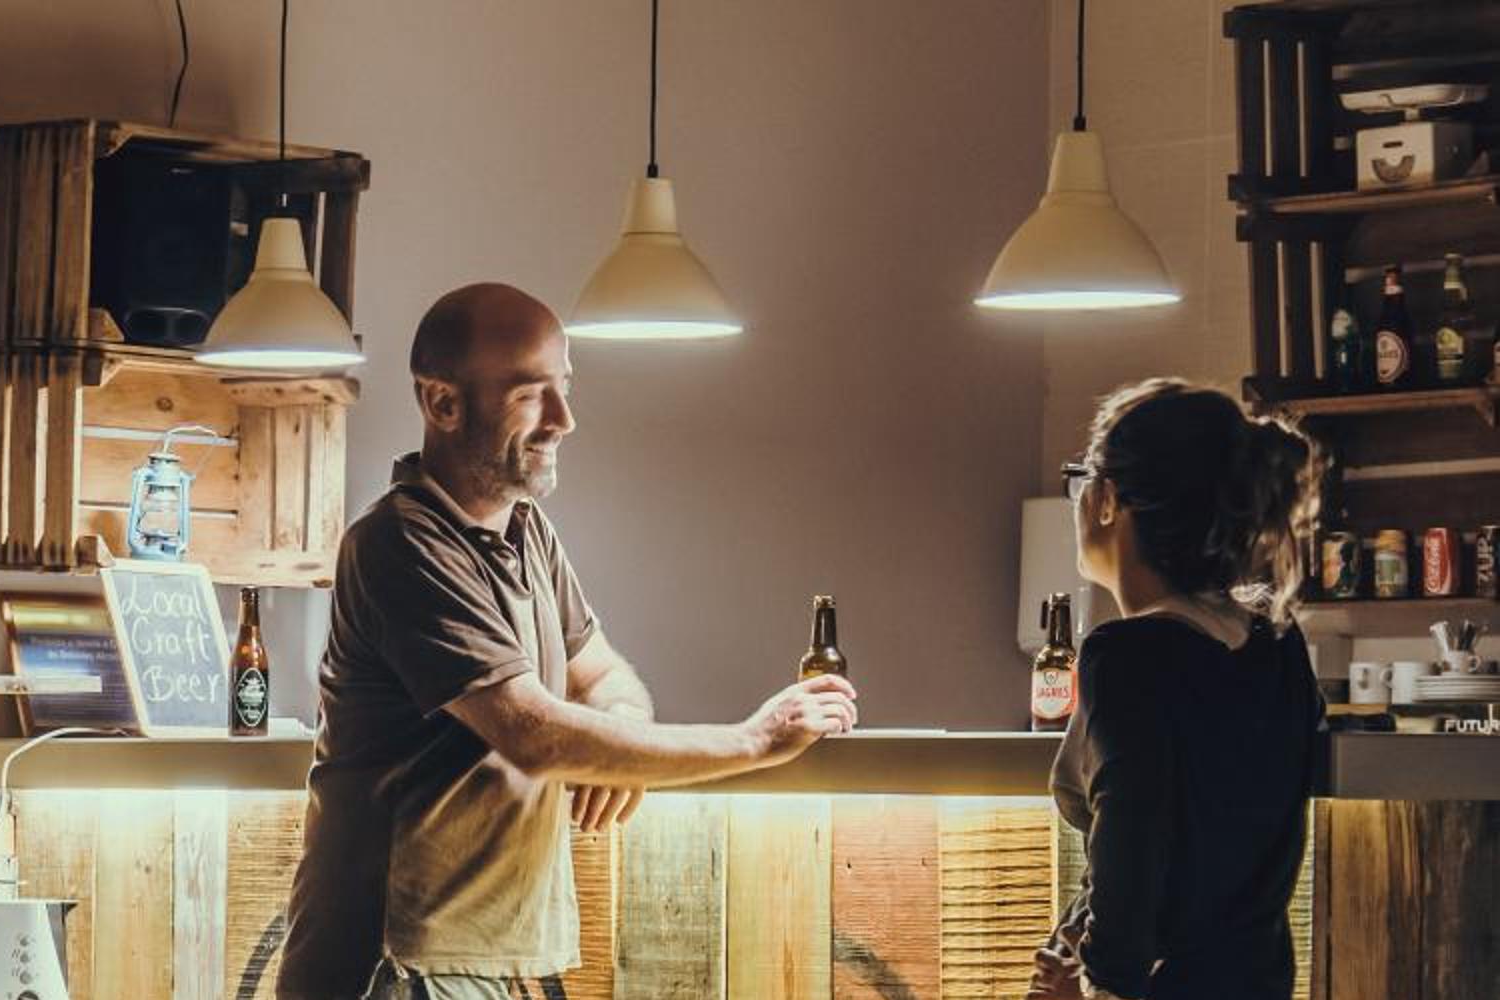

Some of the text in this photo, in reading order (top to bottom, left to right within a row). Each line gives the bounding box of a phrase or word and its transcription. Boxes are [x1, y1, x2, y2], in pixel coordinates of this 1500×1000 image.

[122, 576, 207, 624] Local
[131, 615, 211, 664] Craft
[143, 665, 221, 705] Beer
